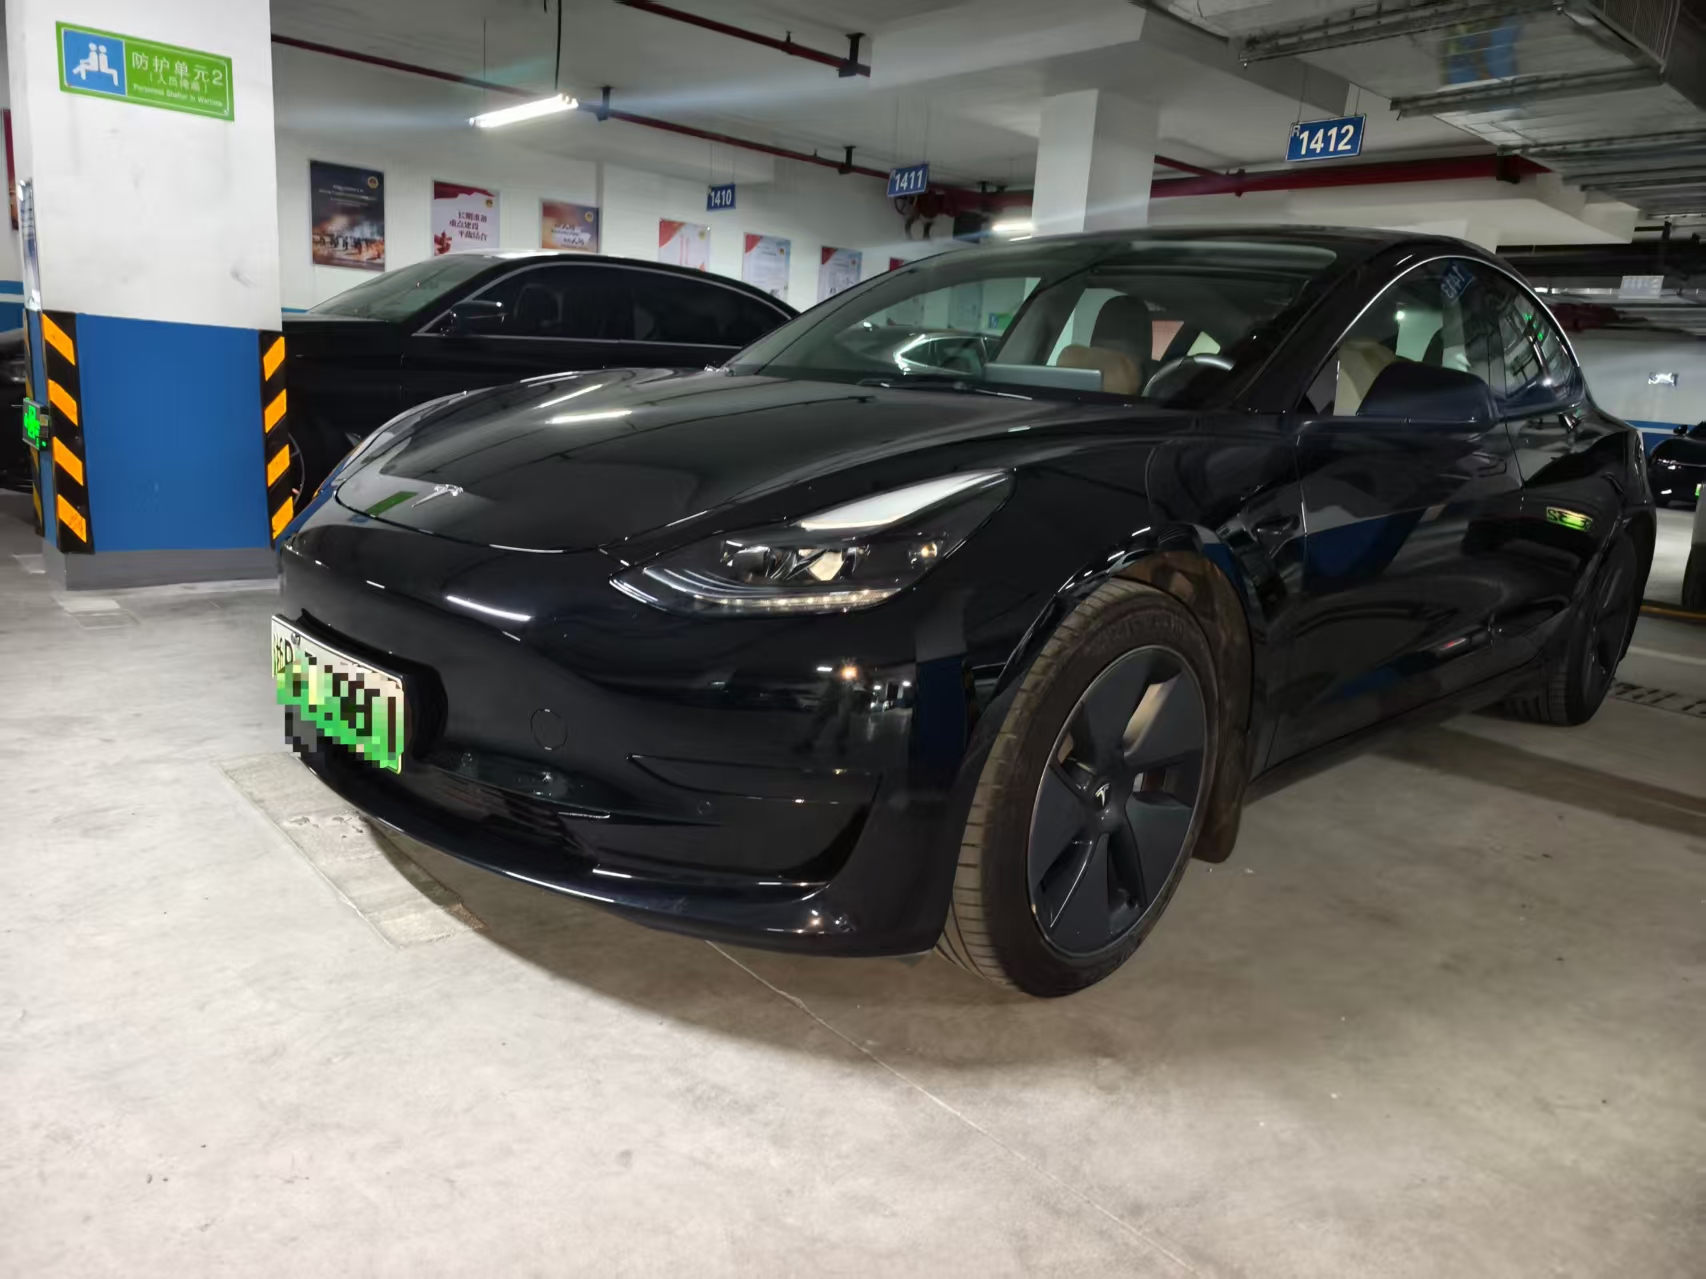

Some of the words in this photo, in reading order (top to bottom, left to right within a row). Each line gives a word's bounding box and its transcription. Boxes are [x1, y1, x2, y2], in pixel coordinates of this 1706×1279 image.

[131, 51, 224, 86] 防护单元2
[1299, 124, 1355, 155] 1412
[895, 168, 923, 192] 1411
[710, 188, 732, 207] 1410
